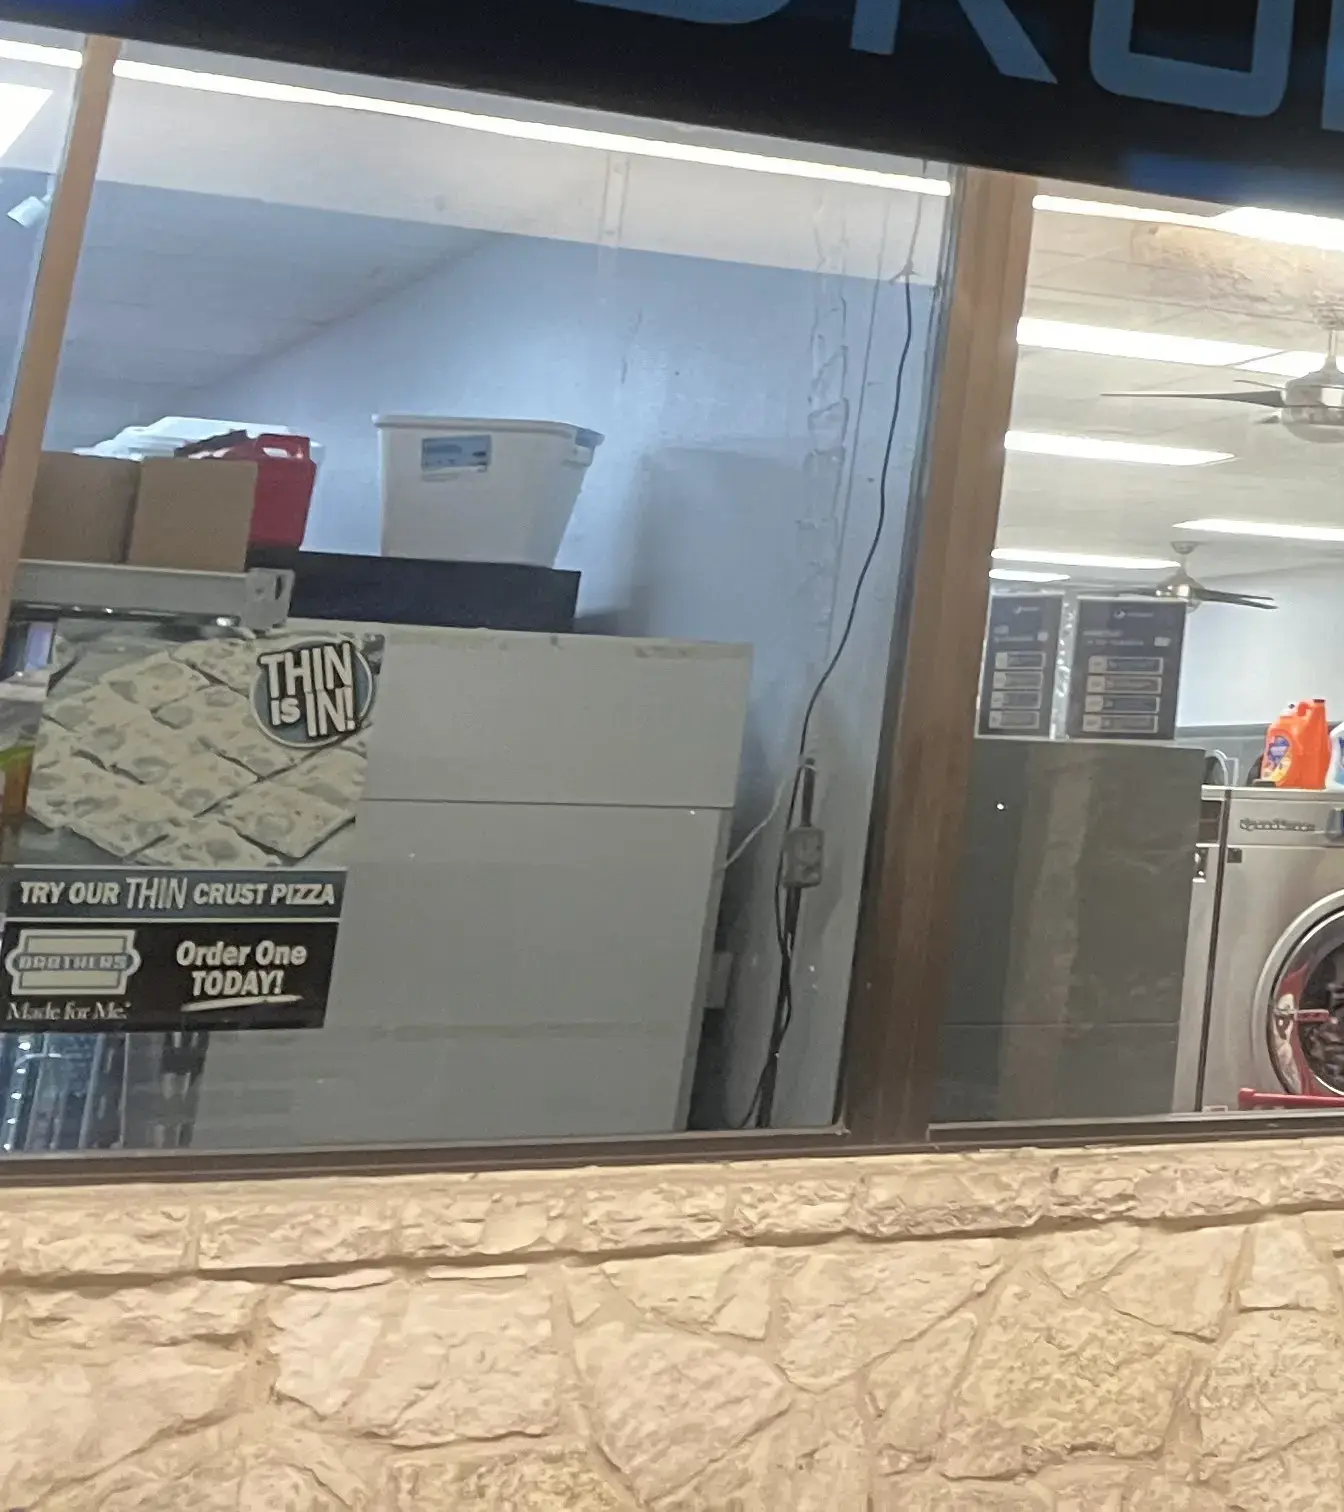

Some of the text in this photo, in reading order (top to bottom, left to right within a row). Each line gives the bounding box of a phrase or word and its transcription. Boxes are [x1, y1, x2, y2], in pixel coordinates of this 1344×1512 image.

[259, 642, 353, 699] THIN
[305, 686, 356, 737] IN!
[19, 876, 336, 910] TRY OUR THIN CRUST PIZZA
[175, 940, 308, 967] Order One
[190, 969, 285, 997] TODAY!
